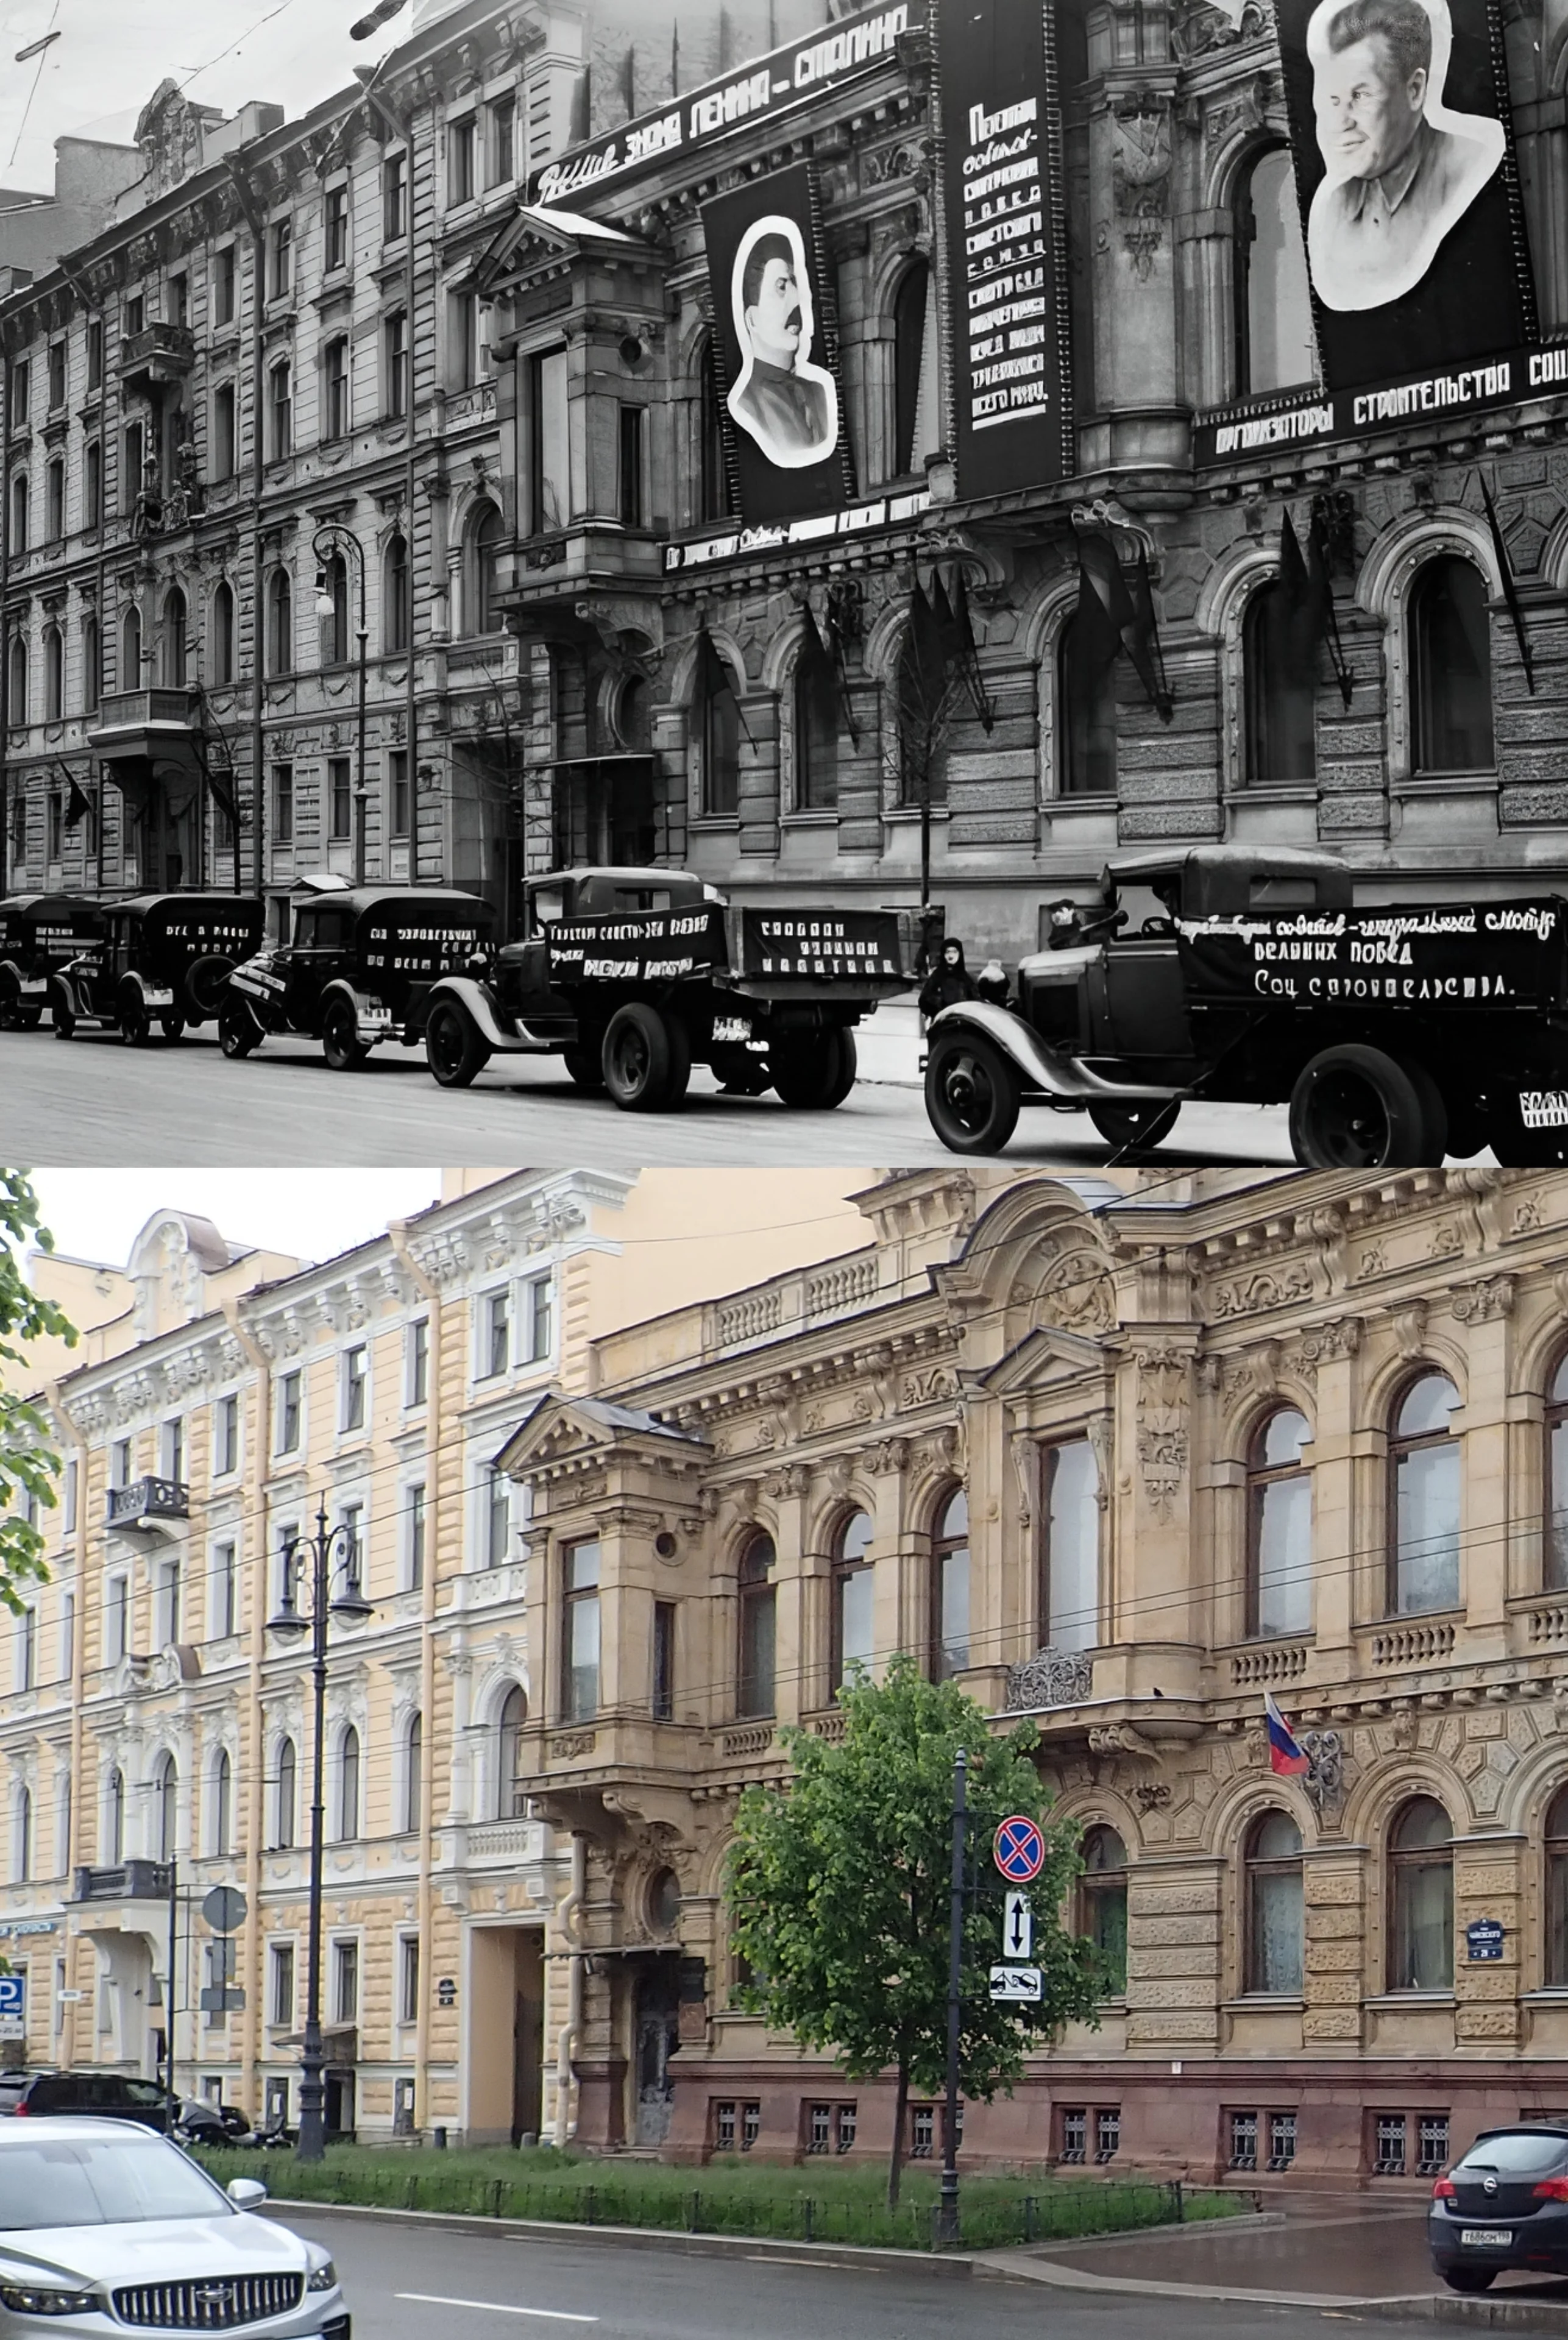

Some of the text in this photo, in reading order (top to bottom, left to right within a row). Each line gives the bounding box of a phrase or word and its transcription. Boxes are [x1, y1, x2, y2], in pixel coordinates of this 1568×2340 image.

[689, 69, 770, 139] ЛЕНИНА
[794, 4, 907, 88] СТАЛИНА
[1353, 363, 1511, 425] СТРОИТЕЛЬСТВА
